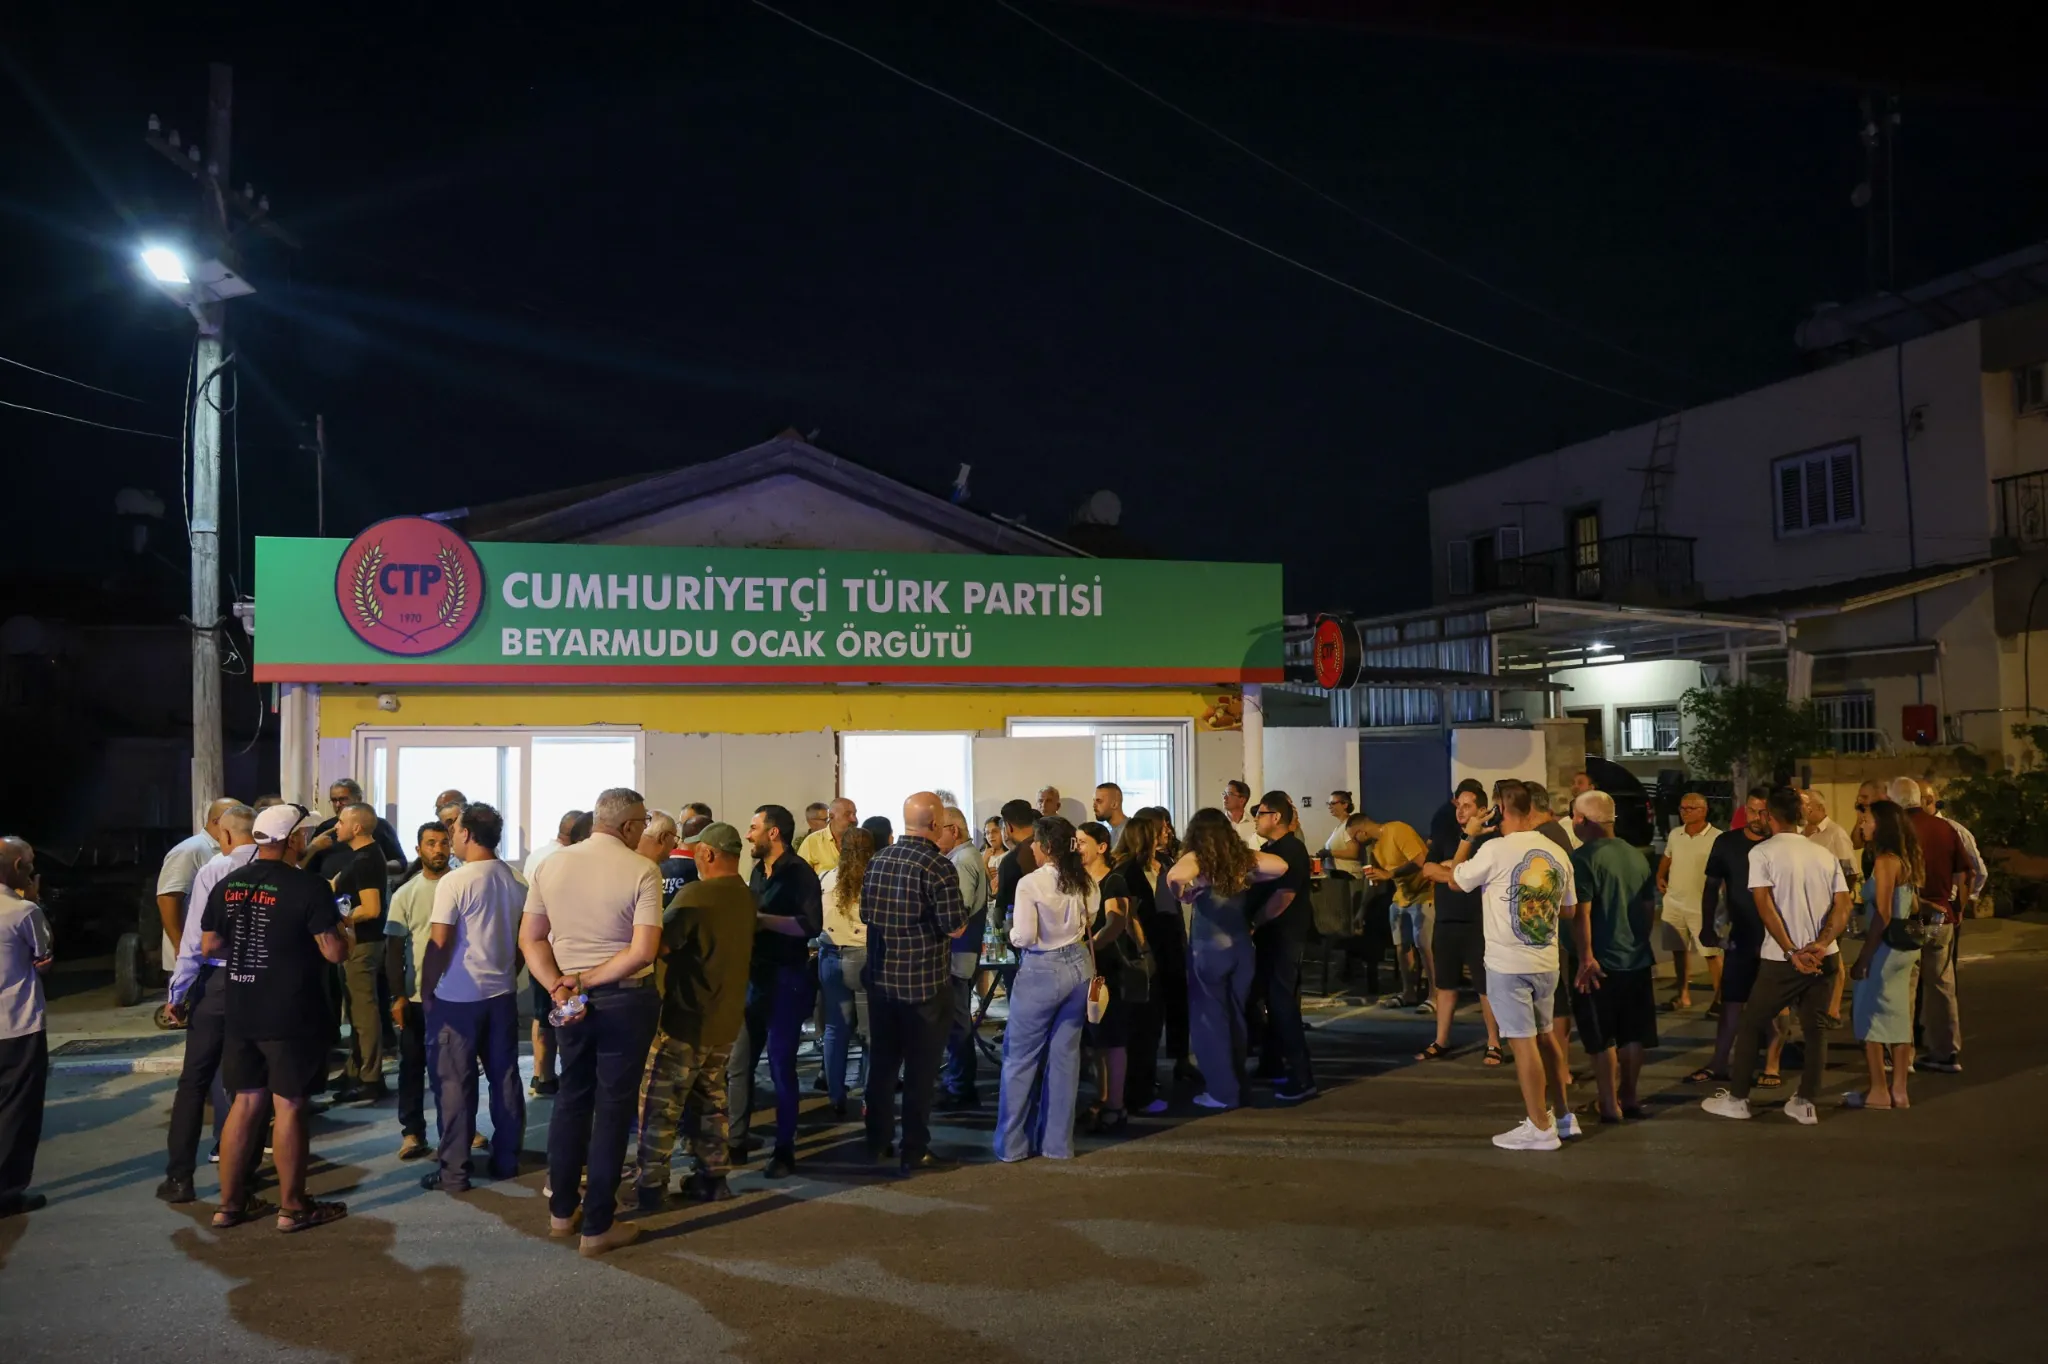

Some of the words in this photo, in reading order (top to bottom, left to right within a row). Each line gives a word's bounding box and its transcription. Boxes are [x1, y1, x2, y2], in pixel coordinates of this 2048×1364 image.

[379, 563, 442, 596] CTP
[502, 565, 827, 622] CUMHURİYETÇİ
[842, 568, 950, 614] TÜRK
[964, 574, 1103, 617] PARTİSİ
[400, 613, 422, 623] 1970
[501, 627, 719, 658] BEYARMUDU
[730, 629, 826, 658] OCAK
[835, 622, 972, 659] ÖRGÜTÜ
[251, 891, 258, 903] A
[258, 892, 276, 905] Fire
[239, 974, 256, 983] 1973
